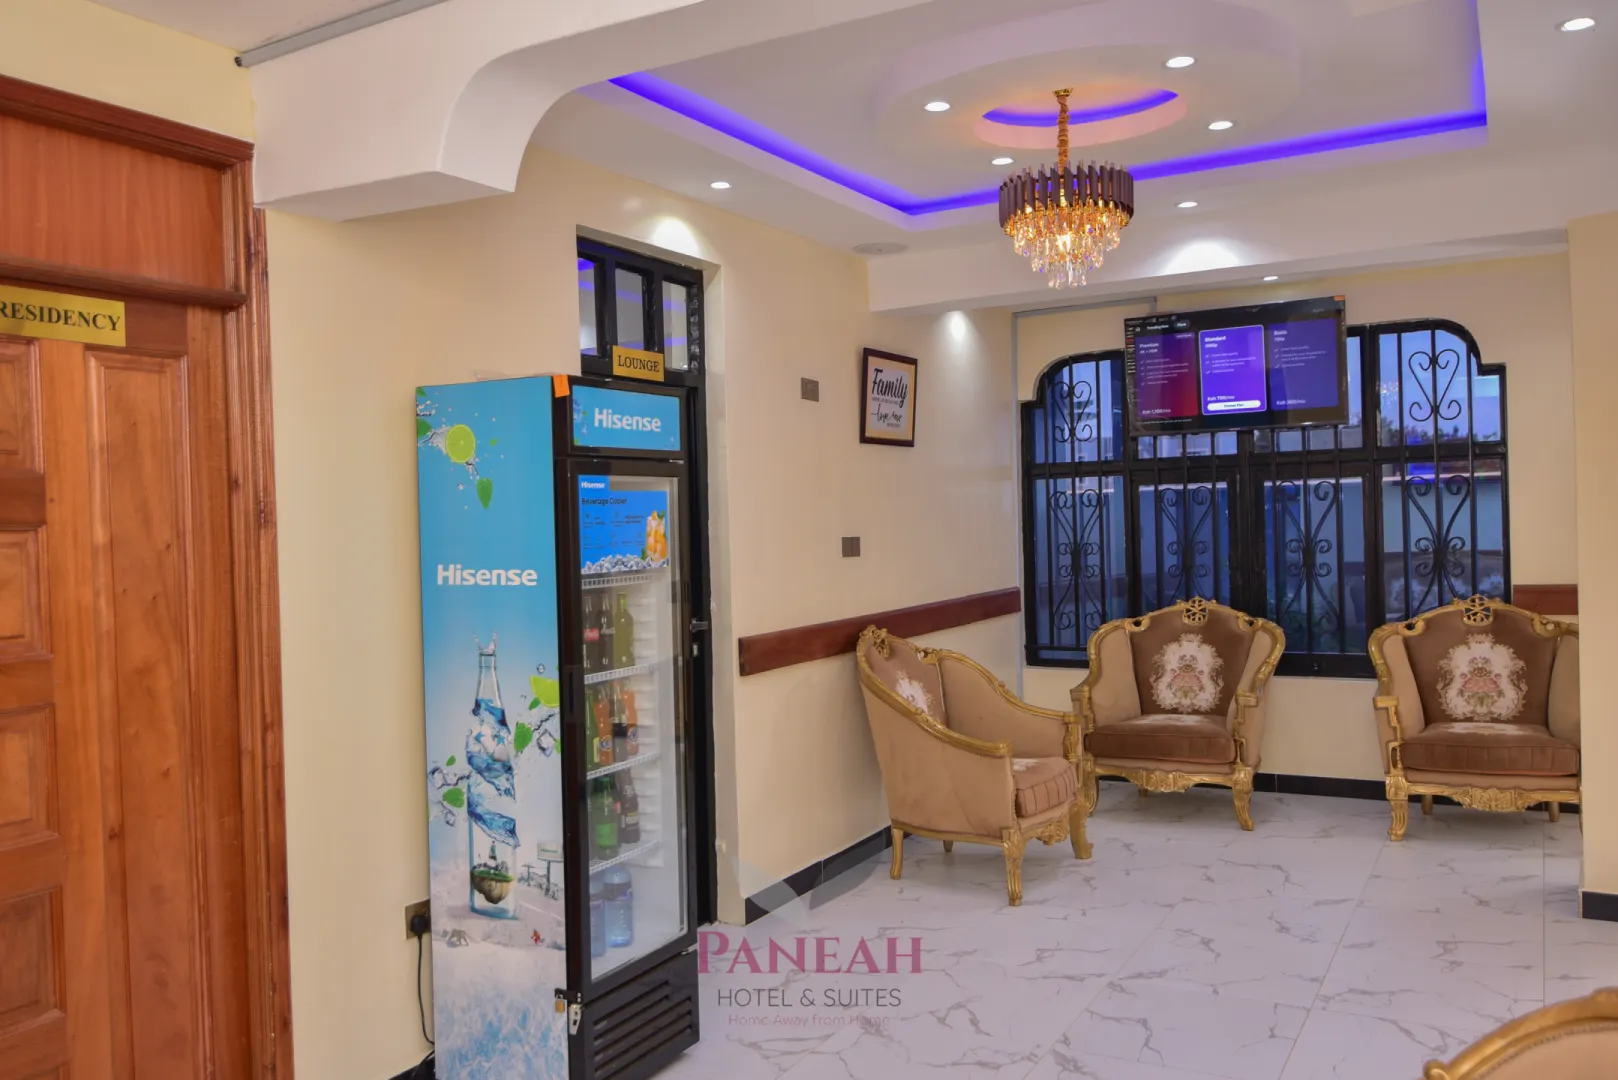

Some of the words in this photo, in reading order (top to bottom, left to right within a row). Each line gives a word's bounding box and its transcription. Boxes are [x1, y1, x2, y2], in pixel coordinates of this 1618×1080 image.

[0, 301, 120, 331] RESIDENCY
[618, 355, 660, 372] LOUNGE
[872, 368, 908, 408] Family
[594, 407, 661, 432] Hisense
[581, 481, 605, 489] Hisense
[582, 497, 608, 506] Beverage
[610, 497, 627, 505] Cooler
[437, 564, 538, 586] Hisense
